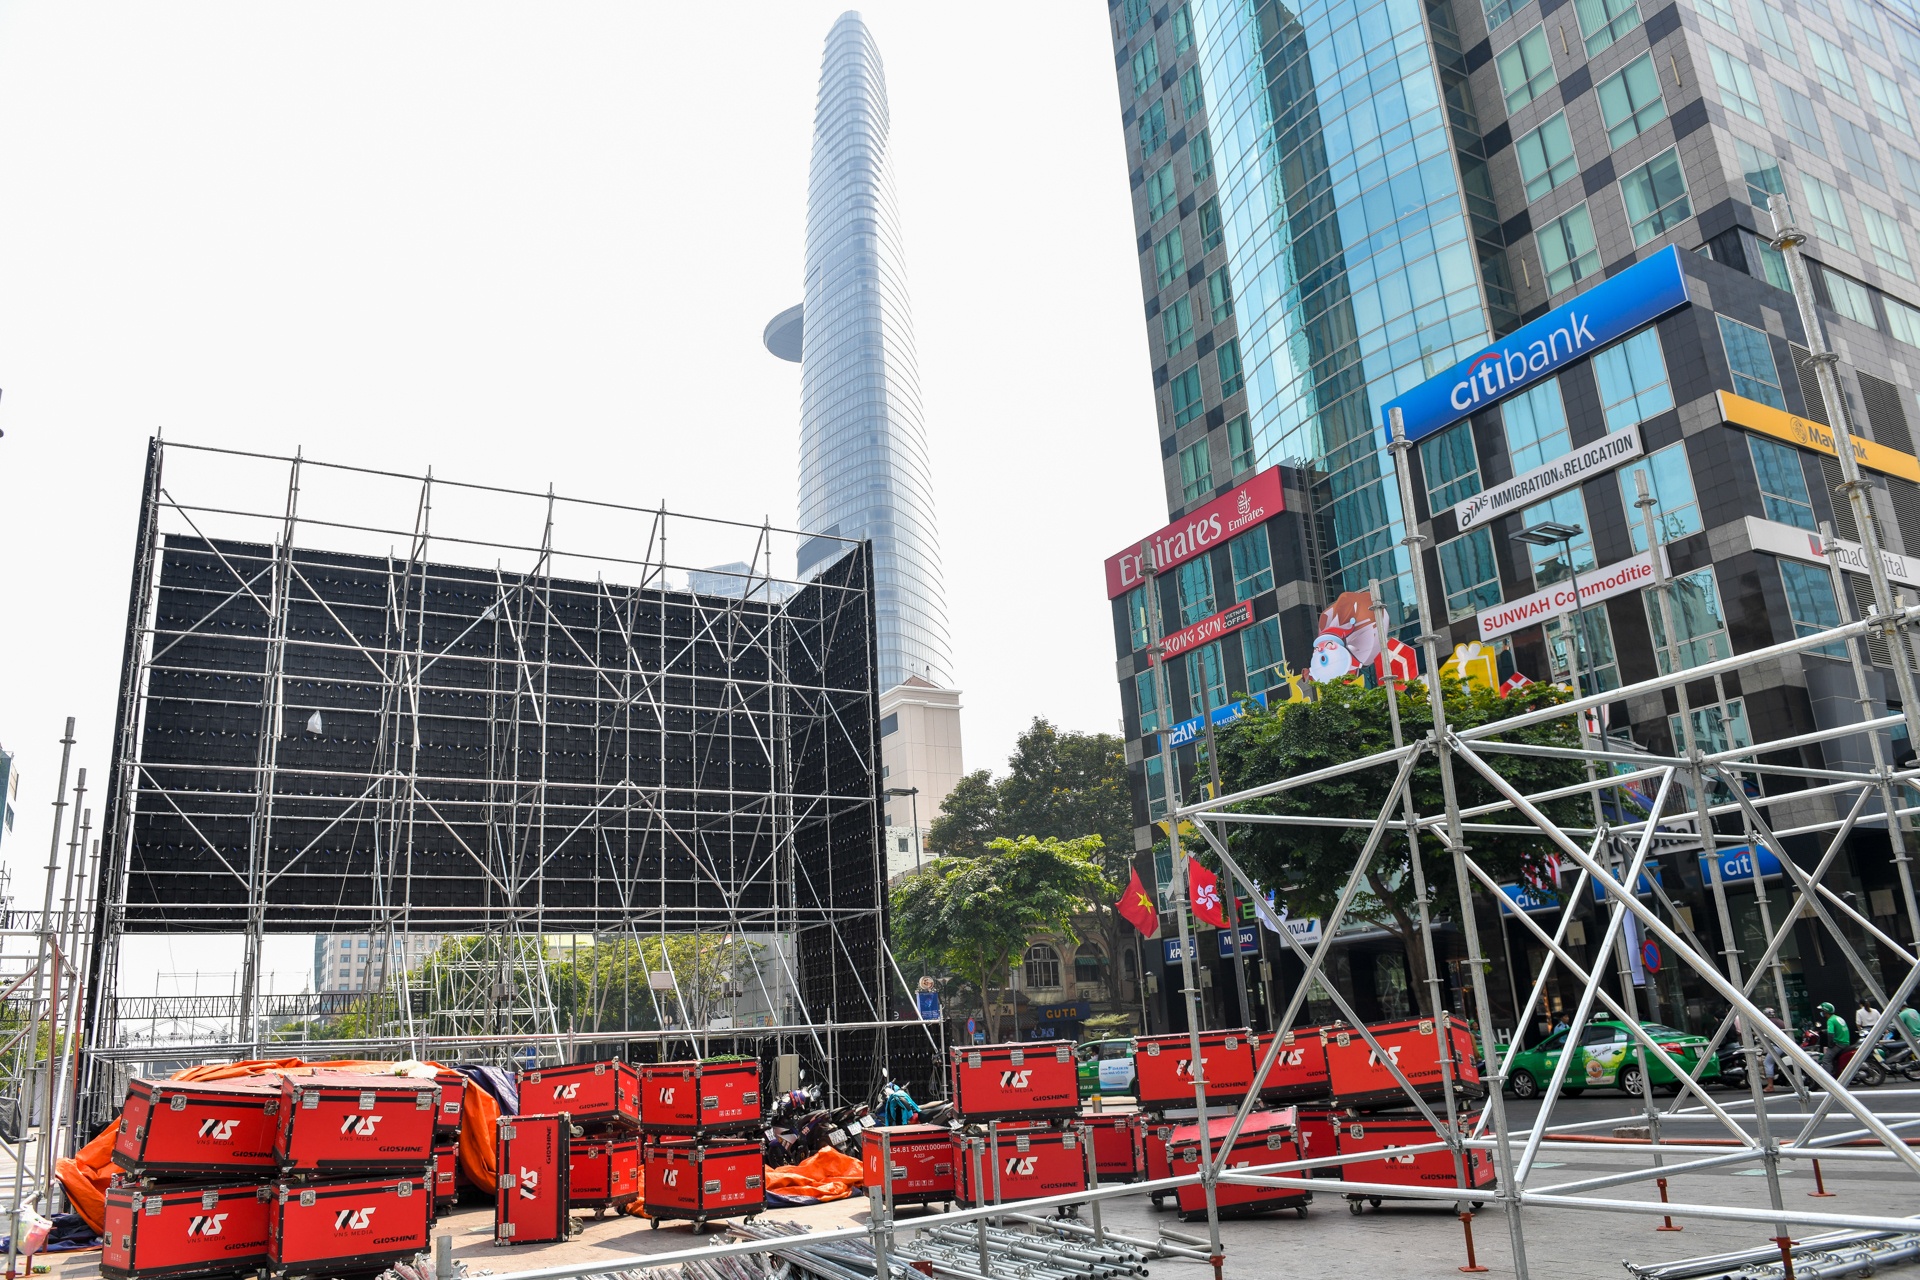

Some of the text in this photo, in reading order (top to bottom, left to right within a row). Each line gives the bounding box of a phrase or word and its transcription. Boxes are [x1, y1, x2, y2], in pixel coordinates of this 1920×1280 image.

[1450, 311, 1596, 411] citibank
[1808, 426, 1868, 460] Maynk
[1228, 505, 1264, 532] Emirates
[1222, 611, 1251, 629] COFFEE
[1224, 607, 1246, 620] VIETNAM
[1483, 597, 1551, 632] SUNWAH
[1149, 618, 1221, 661] KONG SUN
[1724, 854, 1753, 876] cit
[1169, 946, 1195, 959] KPG
[1046, 1008, 1077, 1019] GUTA
[1407, 1069, 1443, 1078] GLOSHIN
[203, 1235, 226, 1243] MEDIA
[350, 1229, 374, 1237] MEDIA
